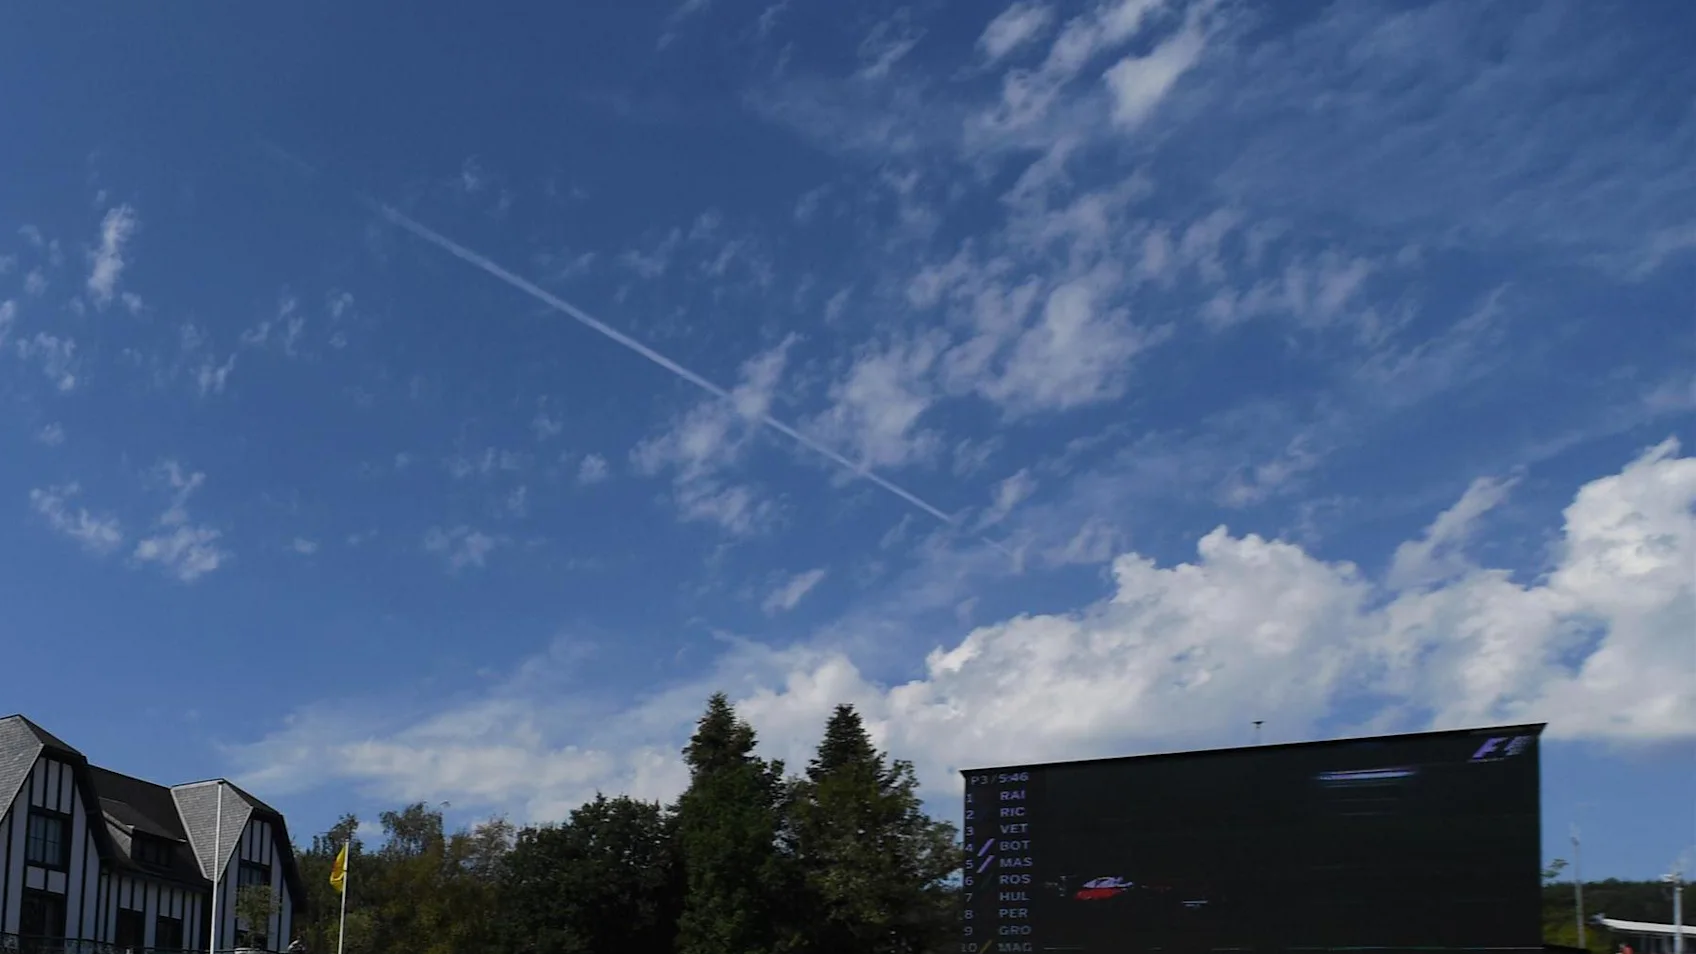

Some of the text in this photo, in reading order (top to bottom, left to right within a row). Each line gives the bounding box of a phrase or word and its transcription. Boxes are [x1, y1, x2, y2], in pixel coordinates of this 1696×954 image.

[1000, 807, 1026, 817] RIC
[999, 823, 1028, 834] VET
[999, 857, 1033, 868] MAS
[999, 874, 1032, 884] ROS
[999, 891, 1031, 901] HUL
[999, 908, 1028, 918] PER
